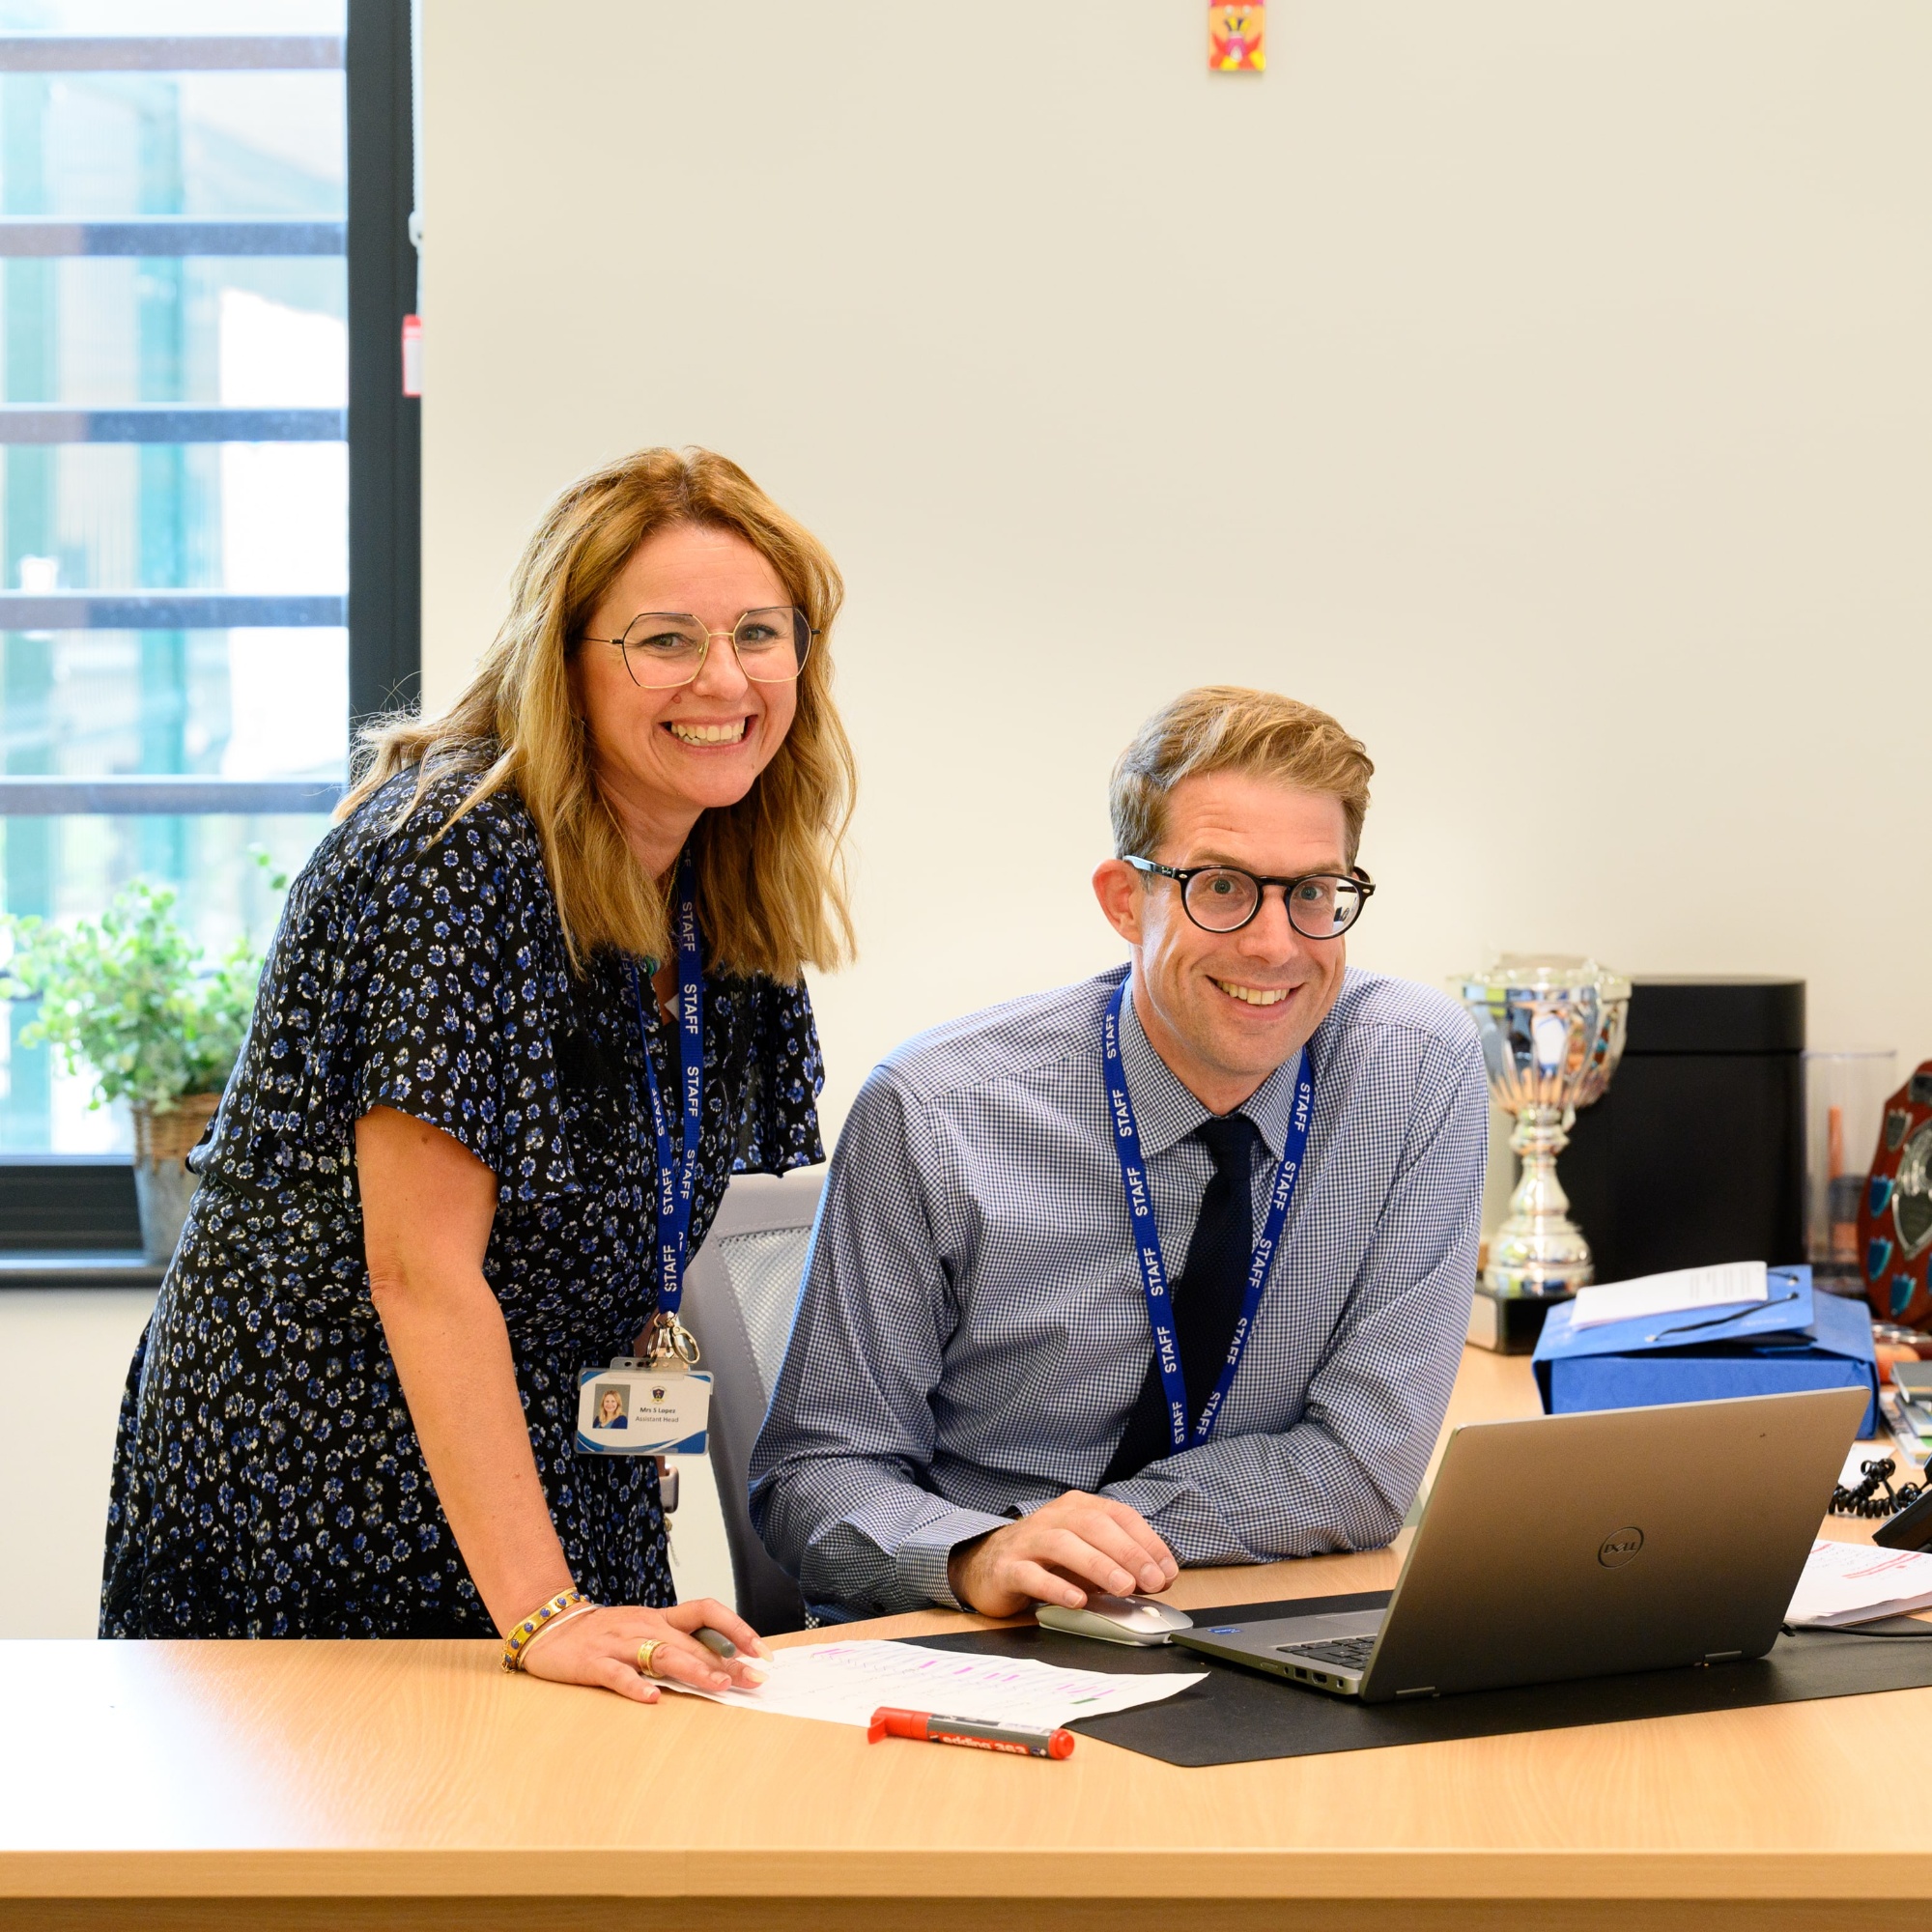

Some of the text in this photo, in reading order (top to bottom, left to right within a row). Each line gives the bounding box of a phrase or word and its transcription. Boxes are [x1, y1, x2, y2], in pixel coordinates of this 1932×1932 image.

[651, 1088, 666, 1137] STAFF
[680, 901, 699, 1200] STAFF STAFF STAFF STAFF
[662, 1167, 673, 1215] STAFF
[663, 1244, 677, 1293] STAFF
[1105, 1012, 1185, 1445] STAFF STAFF STAFF STAFF STAFF STAFF
[1196, 1082, 1311, 1435] STAFF STAFF STAFF STAFF STAFF
